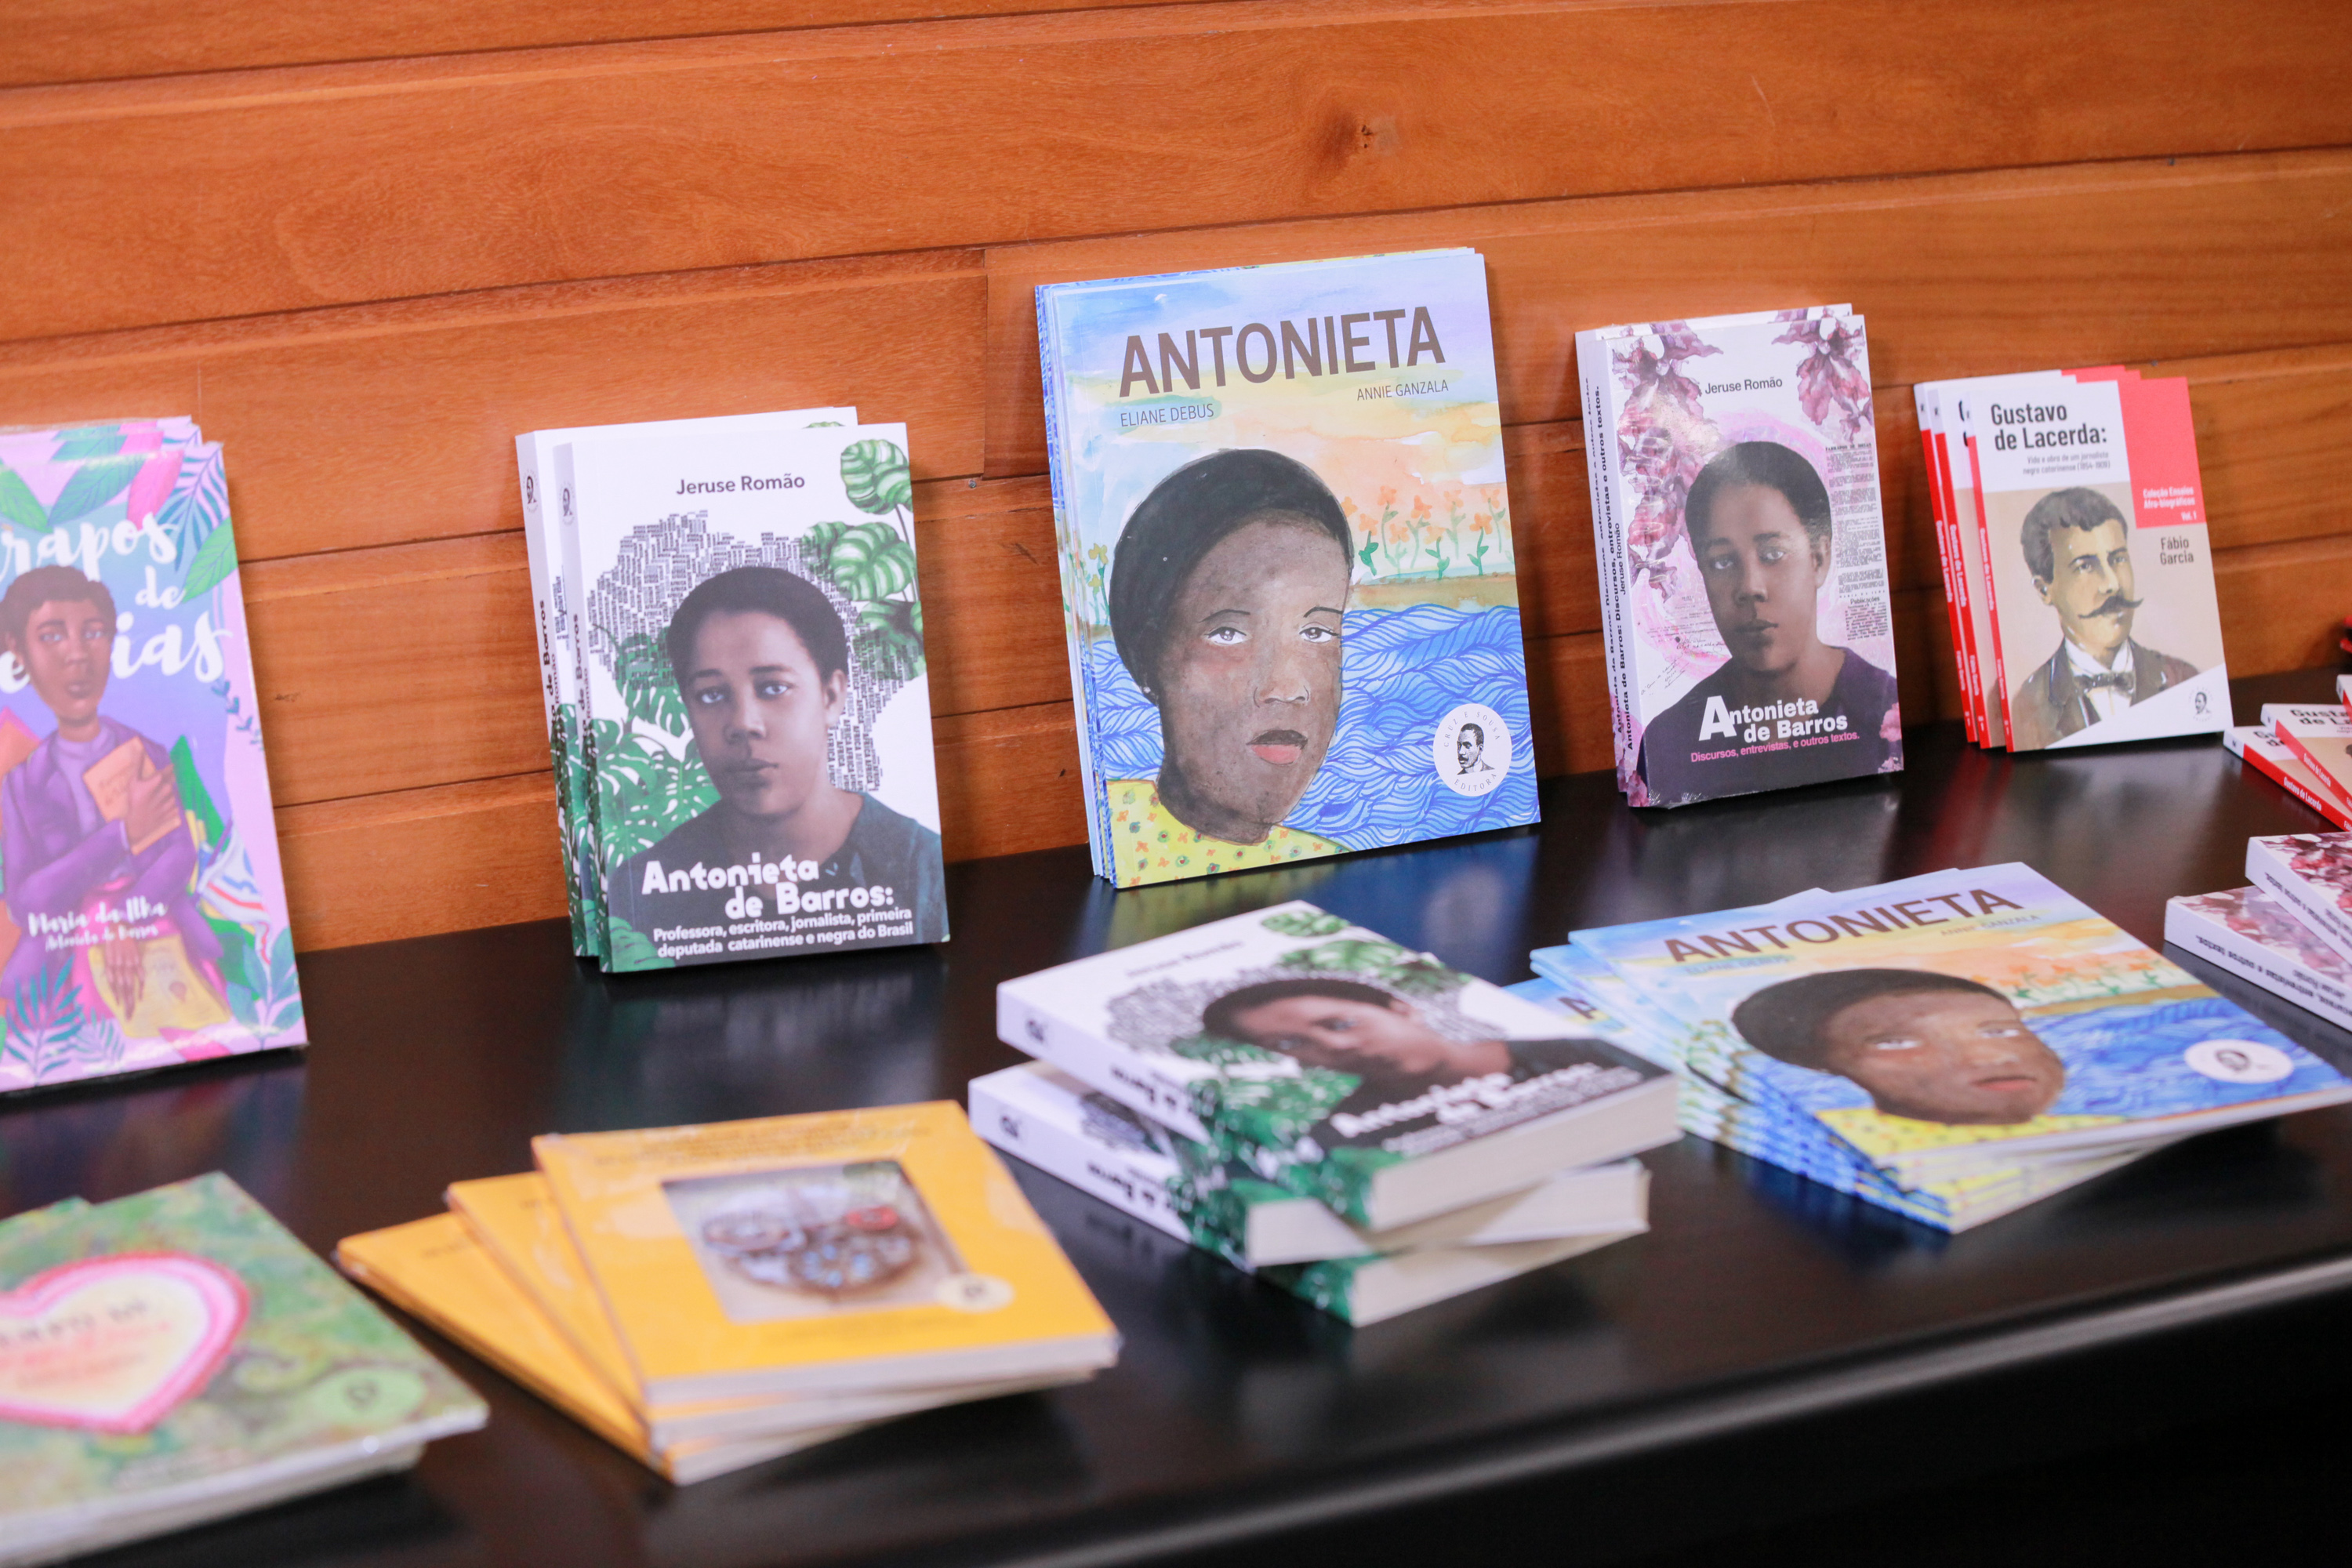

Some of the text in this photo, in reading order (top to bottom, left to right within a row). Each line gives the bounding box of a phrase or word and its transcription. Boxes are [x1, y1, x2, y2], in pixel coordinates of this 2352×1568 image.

[1120, 306, 1446, 397] ANTONIETA
[1357, 379, 1449, 401] ANNIE GANZALA
[1704, 376, 1783, 394] Jeruse Romão
[1120, 403, 1214, 427] ELIANE DEBUS
[1991, 403, 2067, 426] Gustavo
[1598, 432, 1606, 471] outros
[1994, 423, 2107, 451] de Lacerda:
[677, 473, 805, 495] Jeruse Romão
[1603, 485, 1615, 554] entrevistas
[2160, 550, 2194, 565] Garcia
[2161, 535, 2190, 550] Fábio
[135, 565, 186, 609] de
[1611, 556, 1621, 621] Discursos,
[1617, 561, 1626, 596] Jeruse
[539, 600, 554, 696] de Barros
[573, 614, 583, 680] Barros
[1617, 624, 1626, 669] Barros:
[1621, 673, 1627, 688] de
[1444, 718, 1458, 747] CRUZ
[1476, 711, 1501, 740] SOUSA
[1621, 691, 1633, 750] Antonieta
[1698, 695, 1819, 742] Antonieta
[1744, 714, 1848, 743] de Barros
[1690, 748, 1739, 763] Discursos,
[1740, 742, 1791, 756] entrevistas,
[1800, 735, 1829, 747] outros
[1831, 731, 1860, 743] textos.
[1454, 774, 1497, 792] EDITORA
[2283, 776, 2322, 811] Gustavo de Lacerda
[641, 852, 819, 895] Antonieta
[725, 882, 894, 920] de Barros:
[653, 907, 912, 942] Professora, escritora, jornalista, primeira
[657, 920, 914, 960] deputada catarinense e negra do Brasil
[1664, 889, 2024, 962] ANTONIETA
